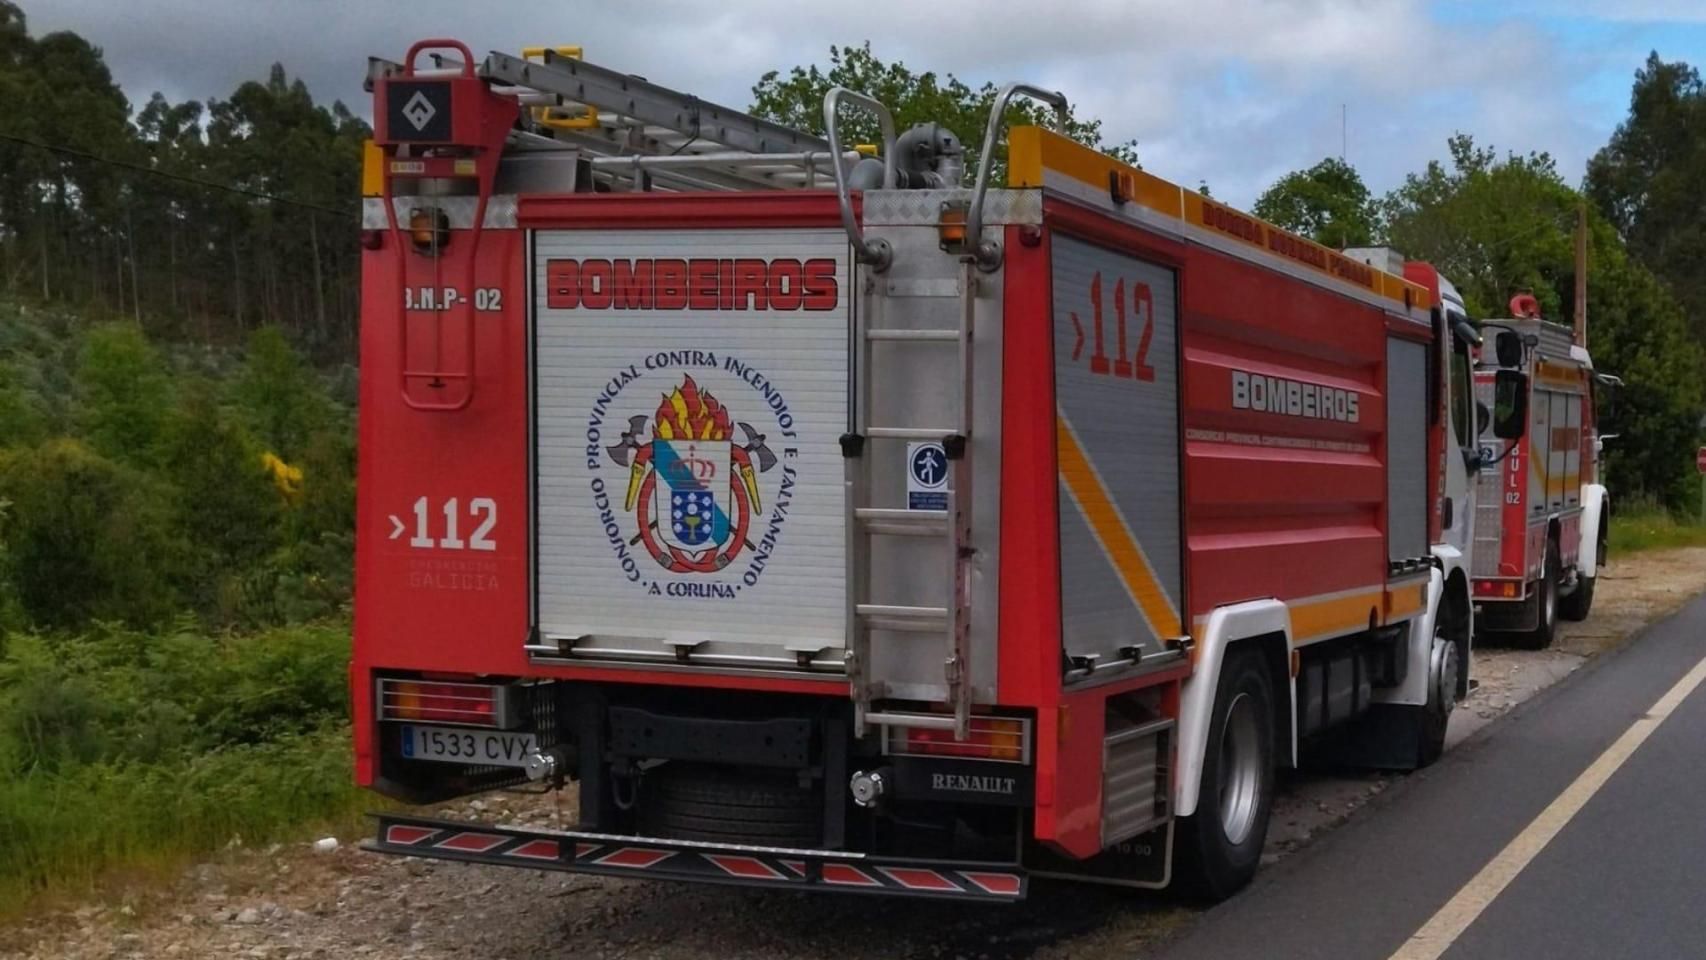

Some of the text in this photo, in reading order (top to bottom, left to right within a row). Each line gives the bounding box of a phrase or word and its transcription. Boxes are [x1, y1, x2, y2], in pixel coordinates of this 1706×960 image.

[475, 288, 502, 310] 02
[547, 258, 838, 311] BOMBEIROS
[1090, 271, 1155, 383] 112
[1232, 370, 1359, 423] BOMBEIROS
[586, 350, 798, 586] CONSORCIO PROVINCIAL CONTRA INCENDIOS E SALVAMENTO
[1506, 491, 1521, 505] 02
[410, 495, 497, 551] 112
[408, 571, 499, 592] GALICIA
[648, 580, 736, 599] A CORUÑA
[421, 731, 476, 758] 1533
[485, 736, 530, 761] CVX
[931, 773, 1016, 794] RENAULT
